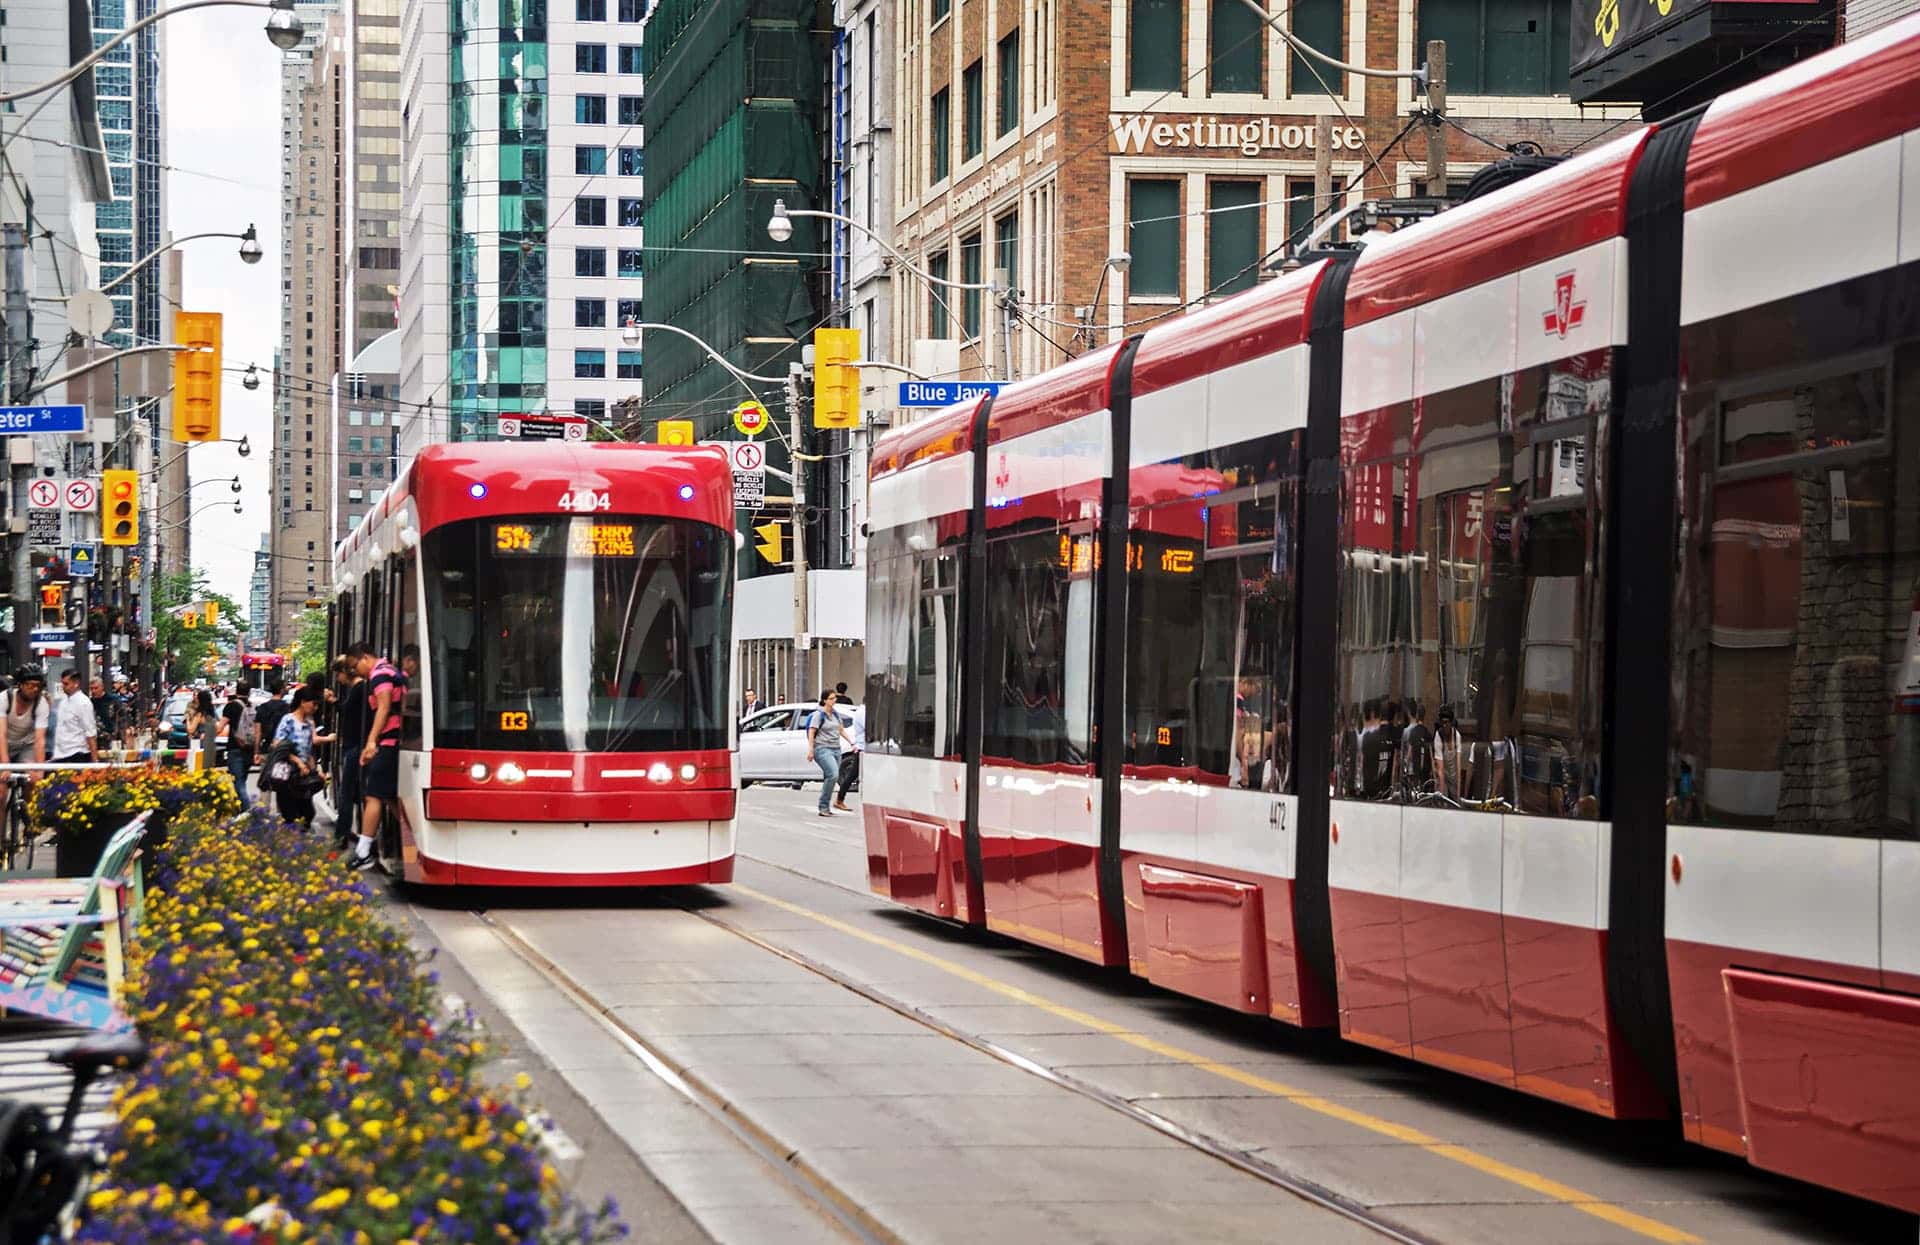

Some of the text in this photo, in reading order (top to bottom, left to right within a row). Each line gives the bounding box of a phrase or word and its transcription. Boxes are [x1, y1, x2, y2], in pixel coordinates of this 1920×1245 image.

[1108, 113, 1366, 156] Westinghouse
[908, 384, 947, 401] Blue
[41, 409, 52, 419] St
[741, 413, 761, 423] NEW
[558, 492, 611, 511] 4404
[599, 541, 634, 555] KING
